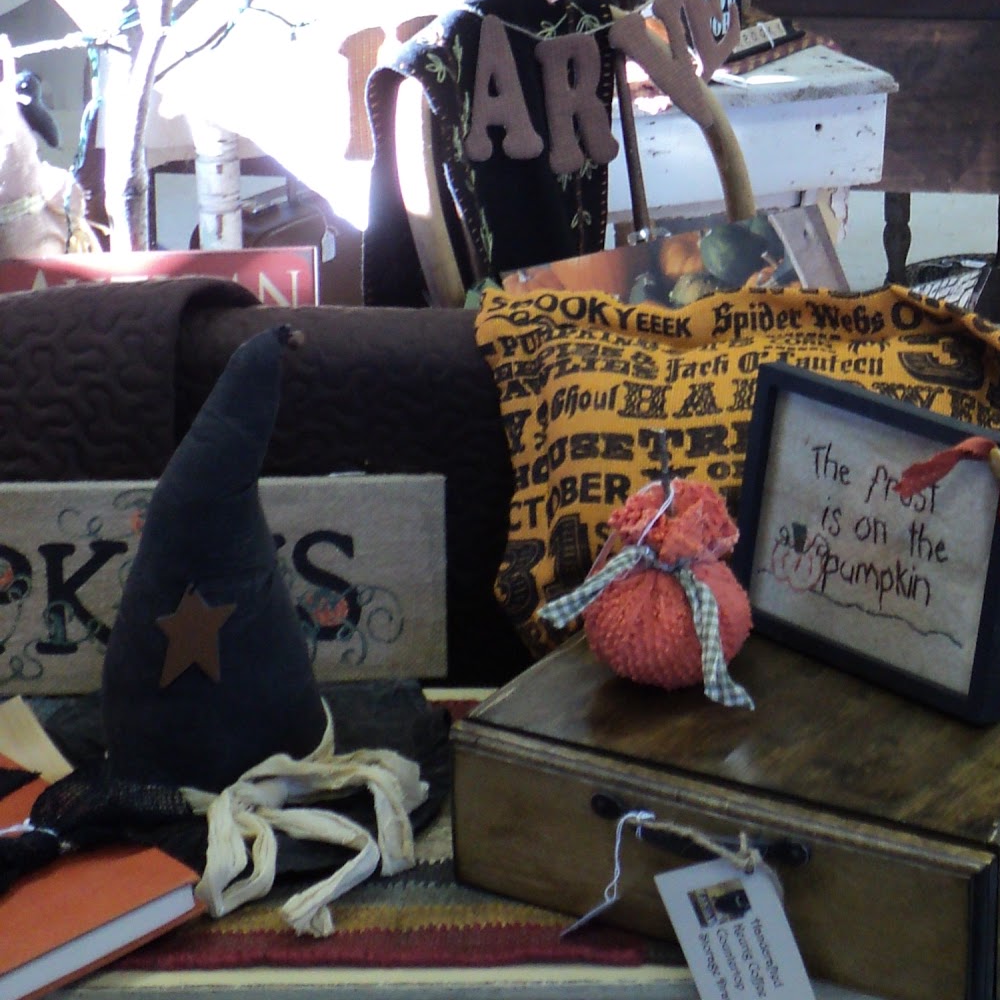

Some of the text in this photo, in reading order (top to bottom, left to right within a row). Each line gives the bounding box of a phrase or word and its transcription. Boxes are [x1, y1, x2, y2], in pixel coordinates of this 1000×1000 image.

[635, 313, 692, 338] EEEK
[711, 302, 800, 338] Spider
[807, 300, 885, 334] Webs
[811, 442, 849, 485] The
[821, 497, 948, 564] is on the
[821, 550, 931, 611] pumpkin
